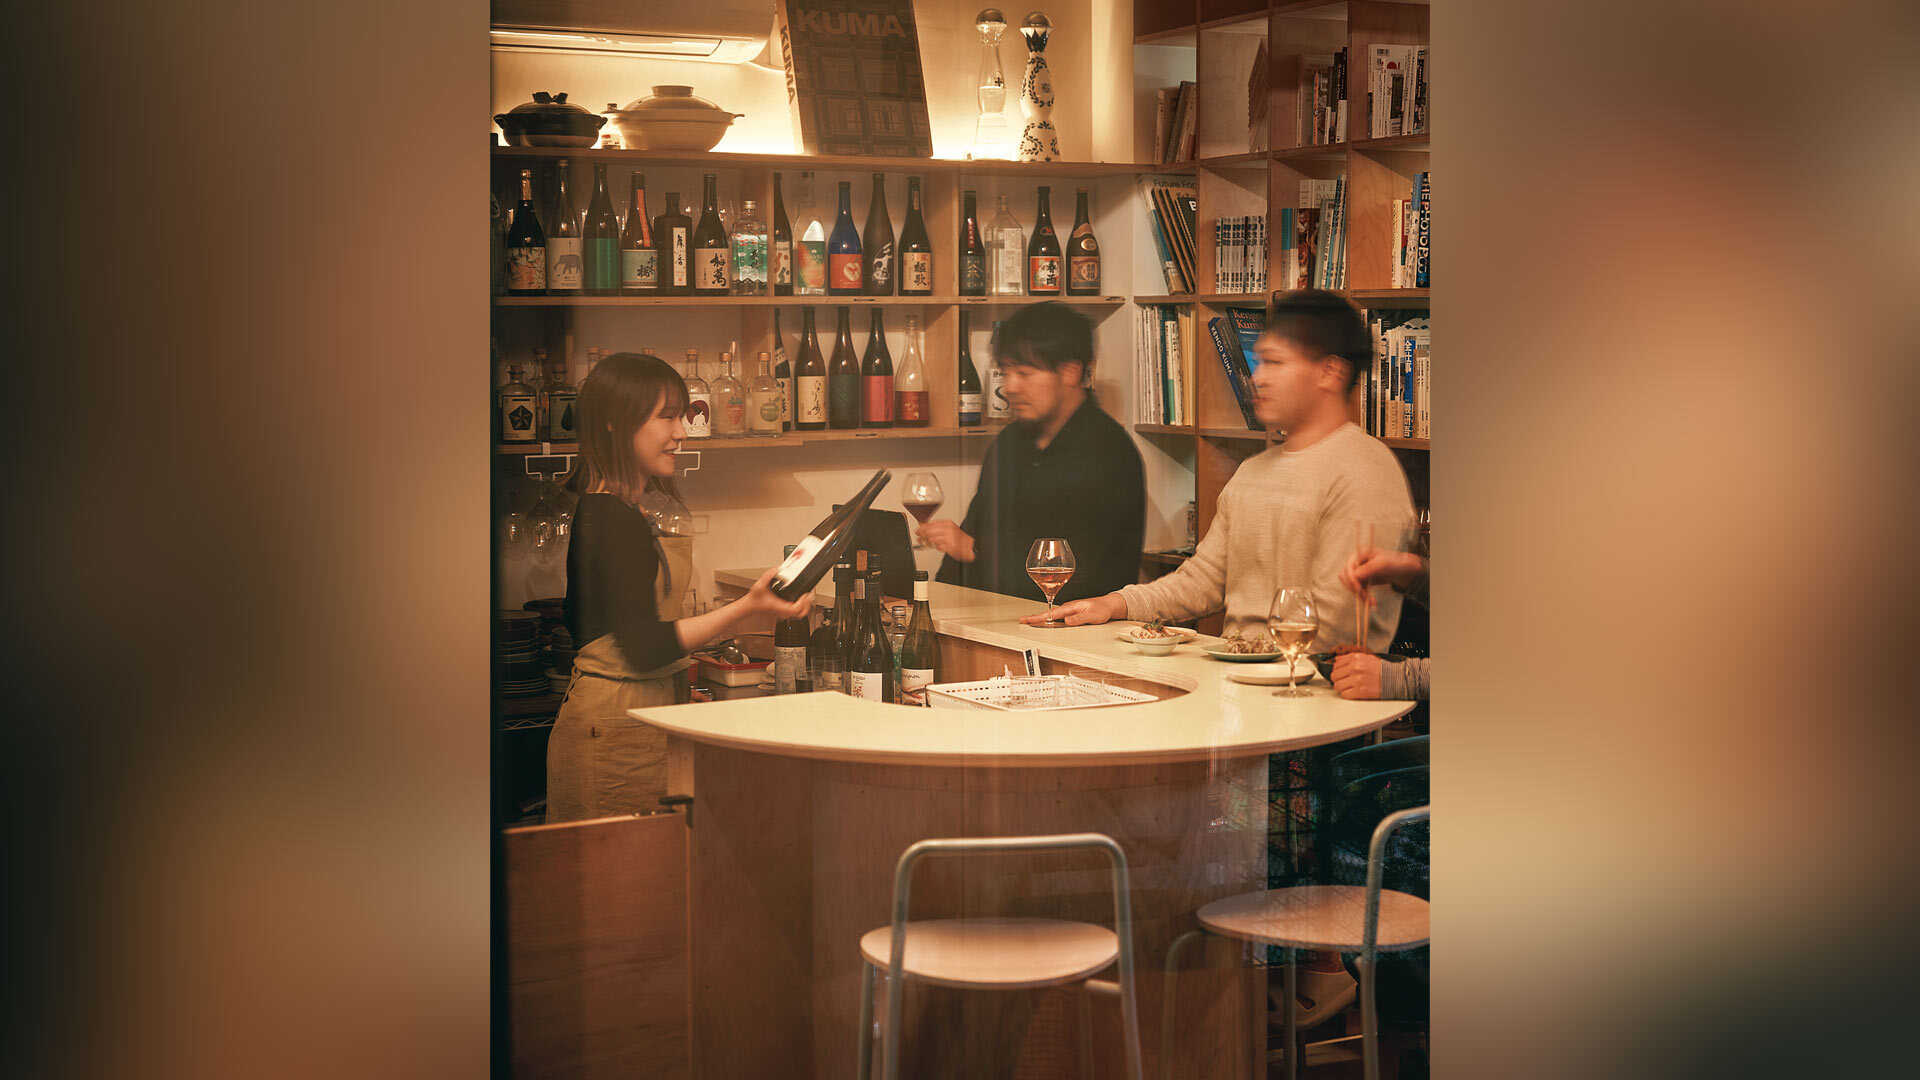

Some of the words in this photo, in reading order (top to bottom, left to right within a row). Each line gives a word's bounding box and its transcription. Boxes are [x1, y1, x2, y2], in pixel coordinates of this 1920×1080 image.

[796, 9, 906, 37] KUMA
[780, 25, 796, 105] KUMA
[1046, 259, 1057, 286] 春雨
[1232, 308, 1263, 322] Kengo
[1236, 319, 1264, 329] Kuma
[1210, 325, 1224, 352] KENGO
[1221, 352, 1232, 376] KUMA
